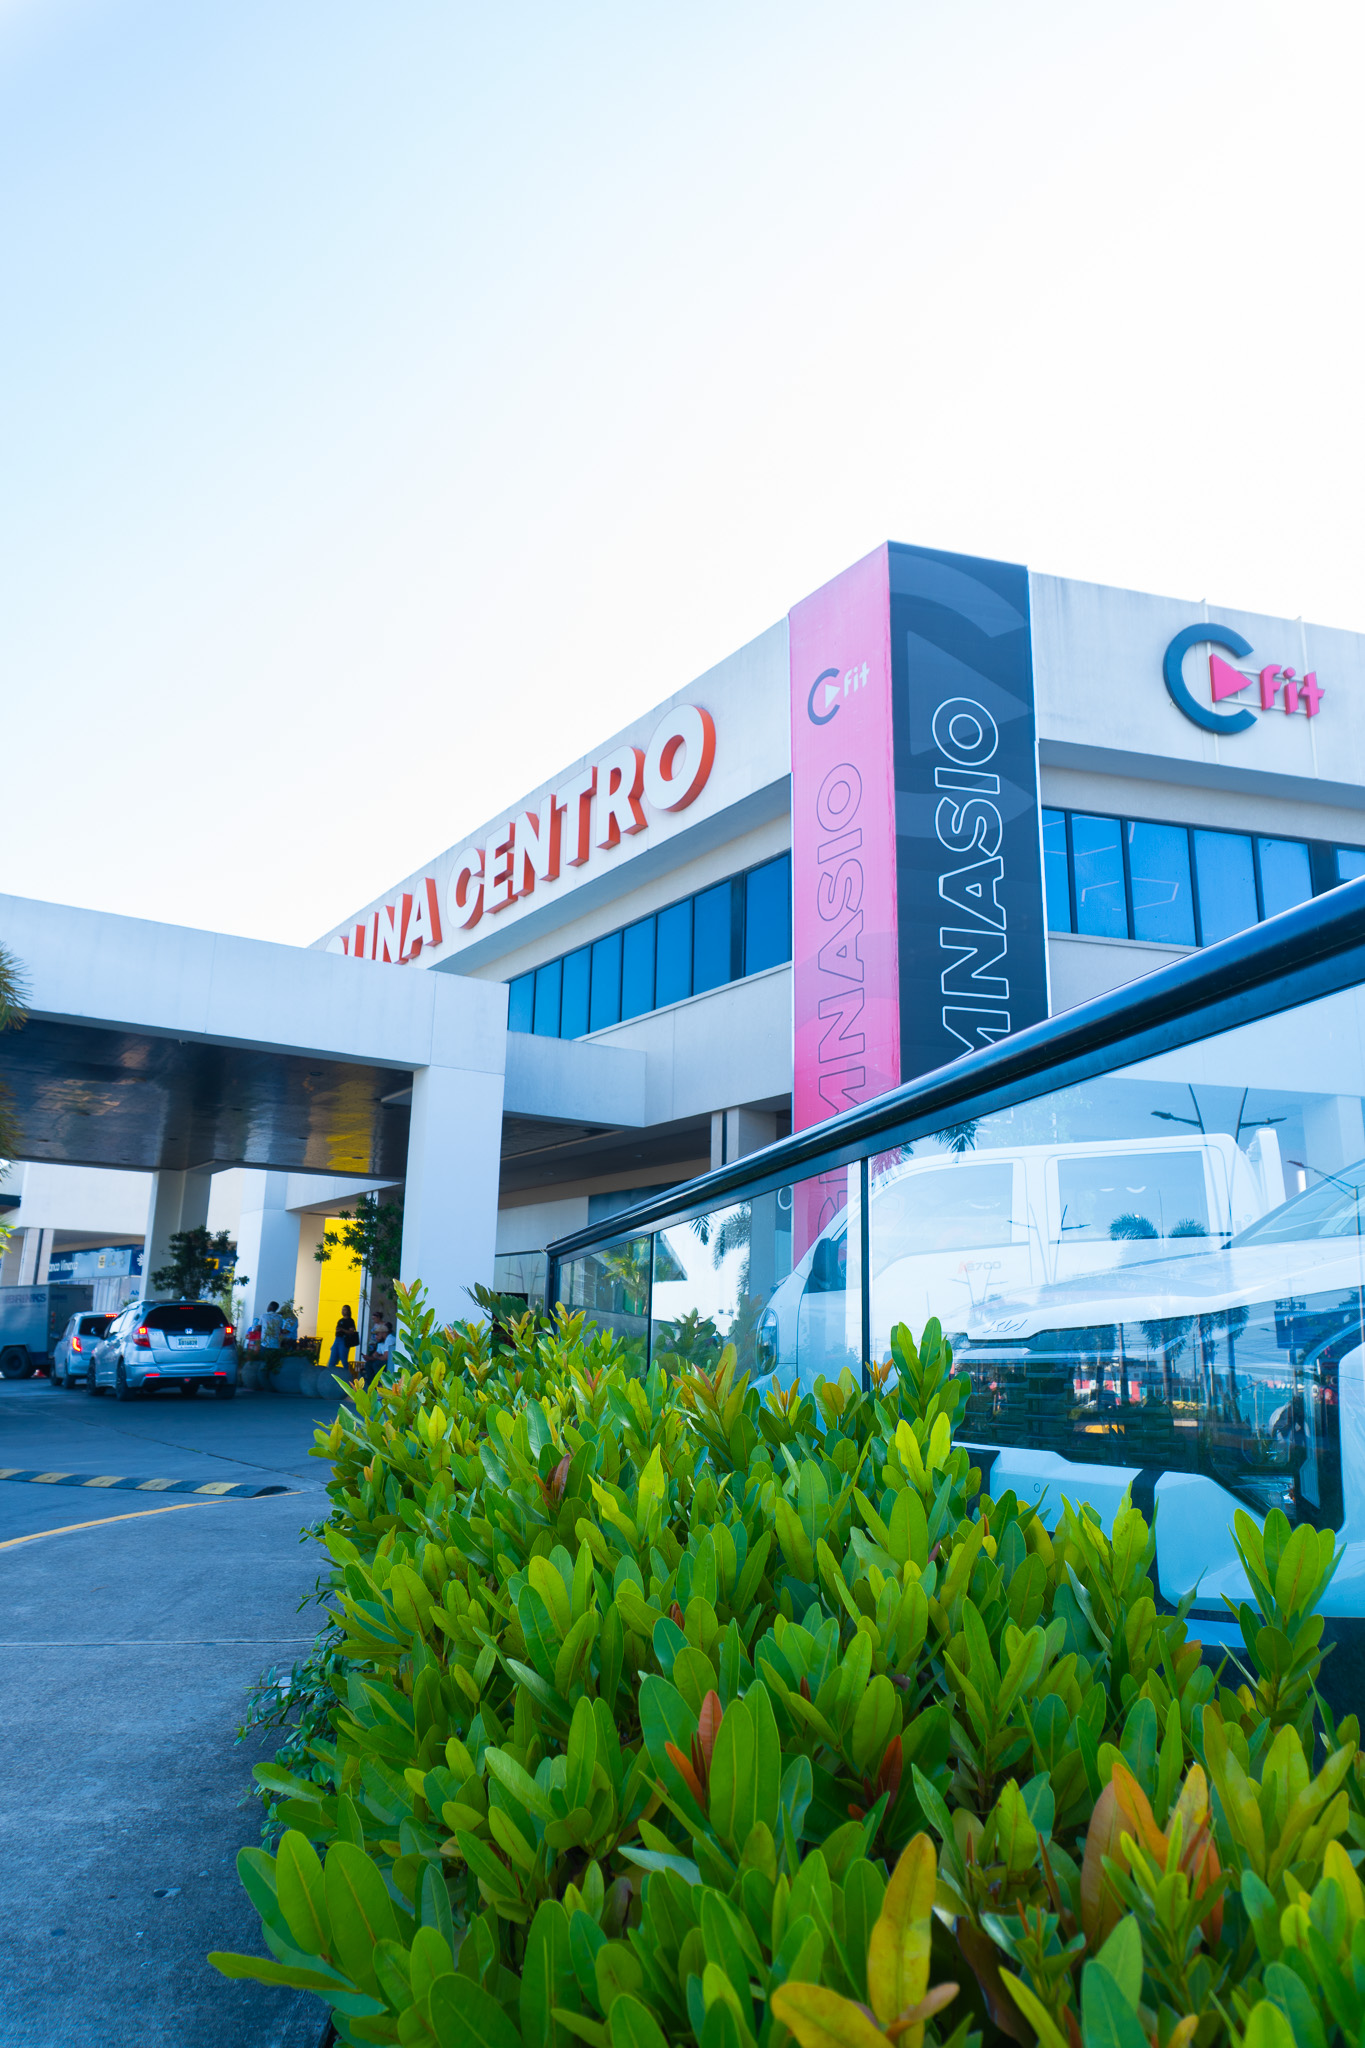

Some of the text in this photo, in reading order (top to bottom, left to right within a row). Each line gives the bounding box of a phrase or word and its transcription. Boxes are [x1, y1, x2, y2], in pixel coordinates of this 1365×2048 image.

[843, 661, 870, 698] fit
[1259, 664, 1325, 719] fit
[325, 703, 717, 965] INA CENTRO
